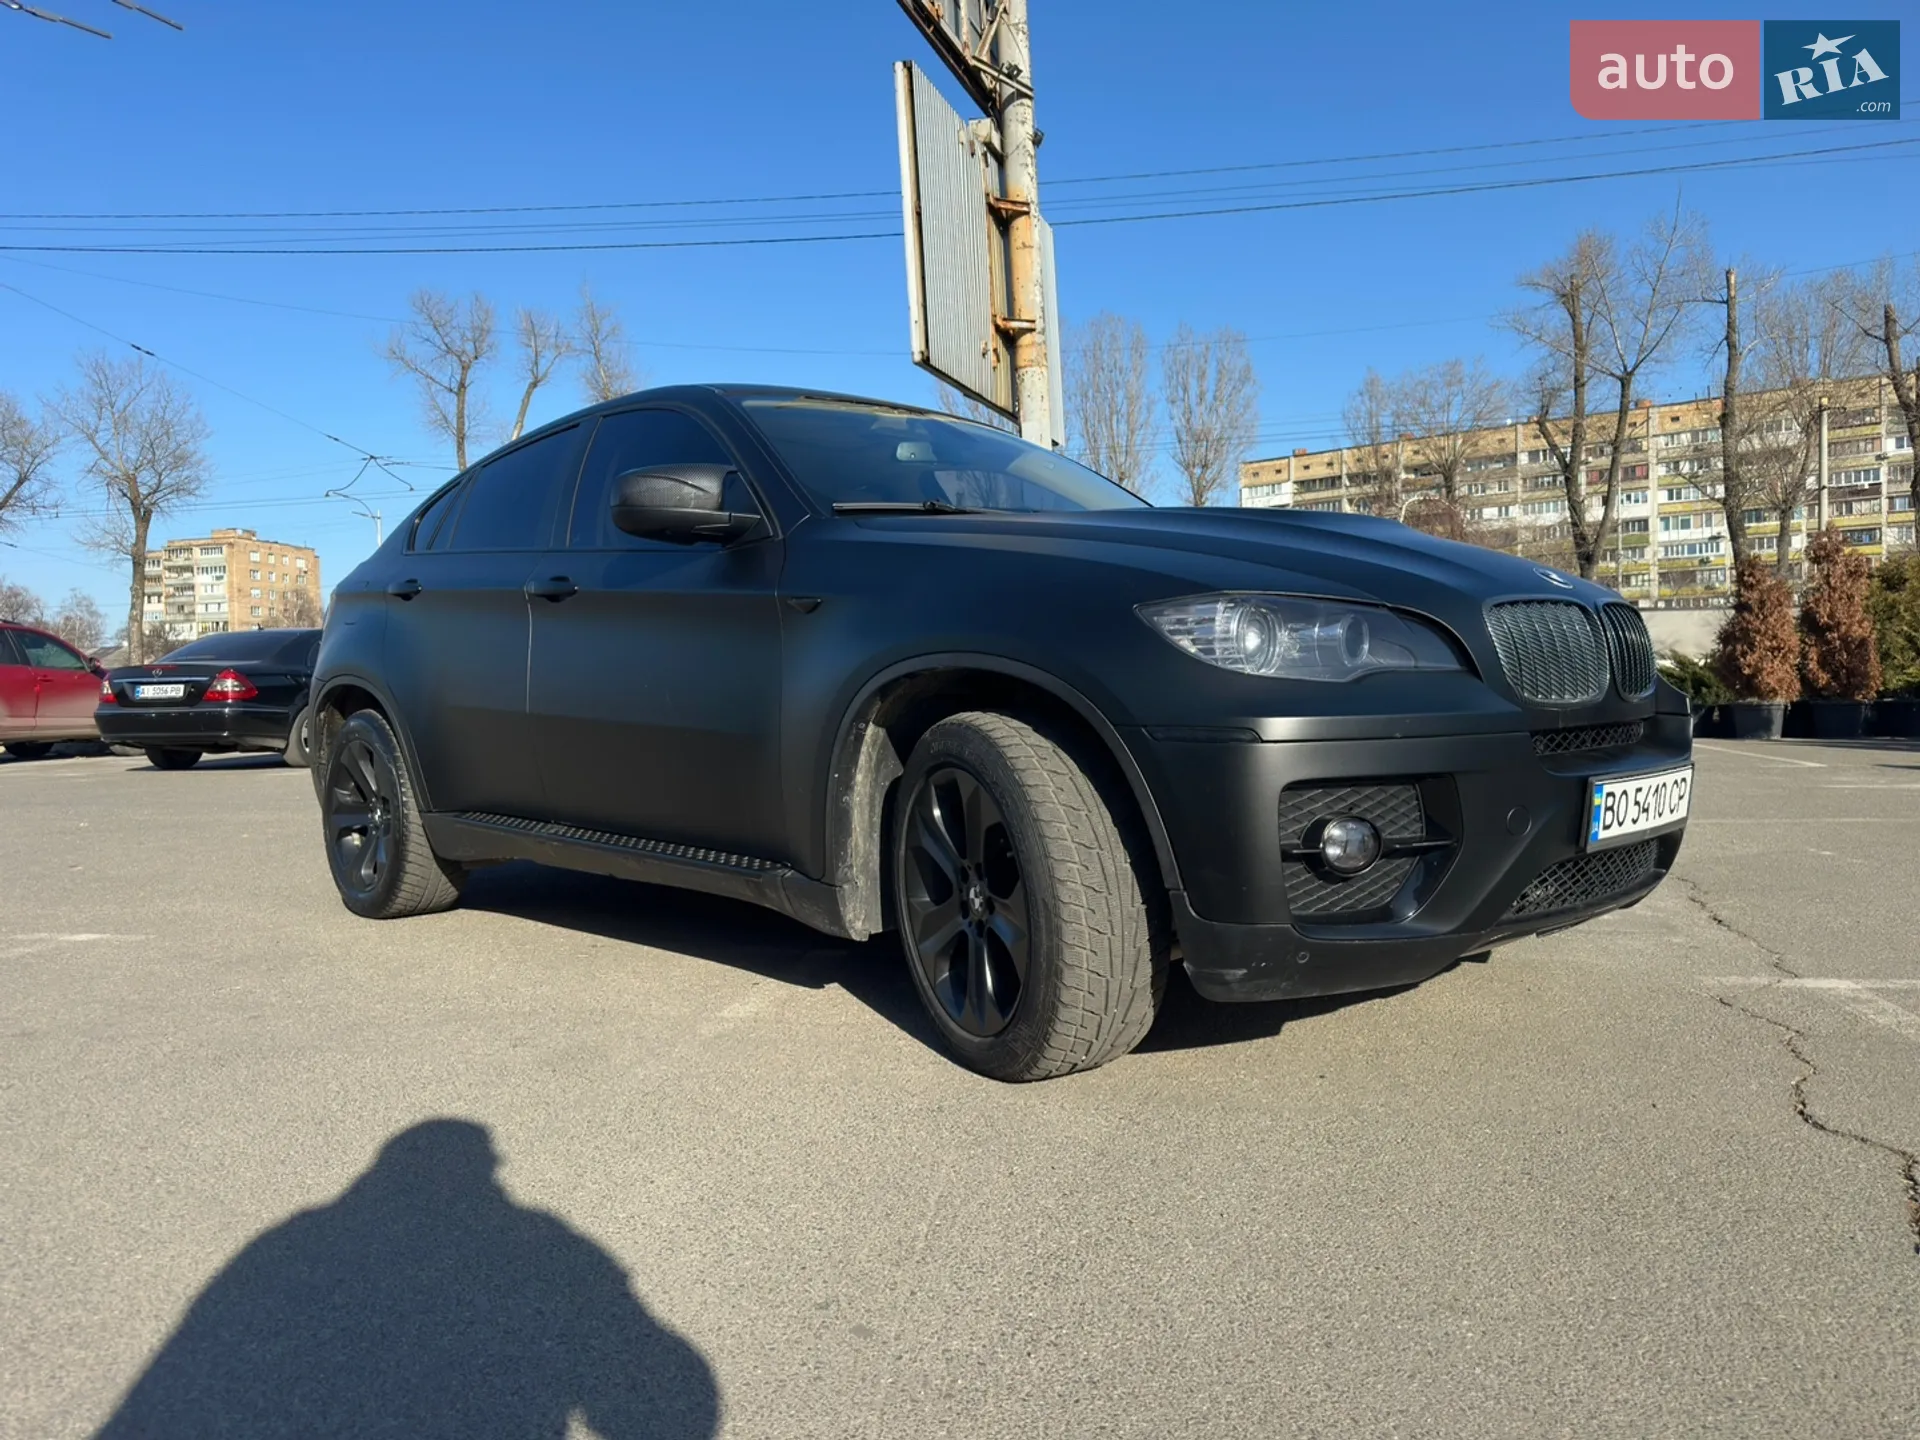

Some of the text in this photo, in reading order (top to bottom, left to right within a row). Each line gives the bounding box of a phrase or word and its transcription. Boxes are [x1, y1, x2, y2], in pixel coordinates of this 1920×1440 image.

[1602, 777, 1687, 831] BO 5410 CP
